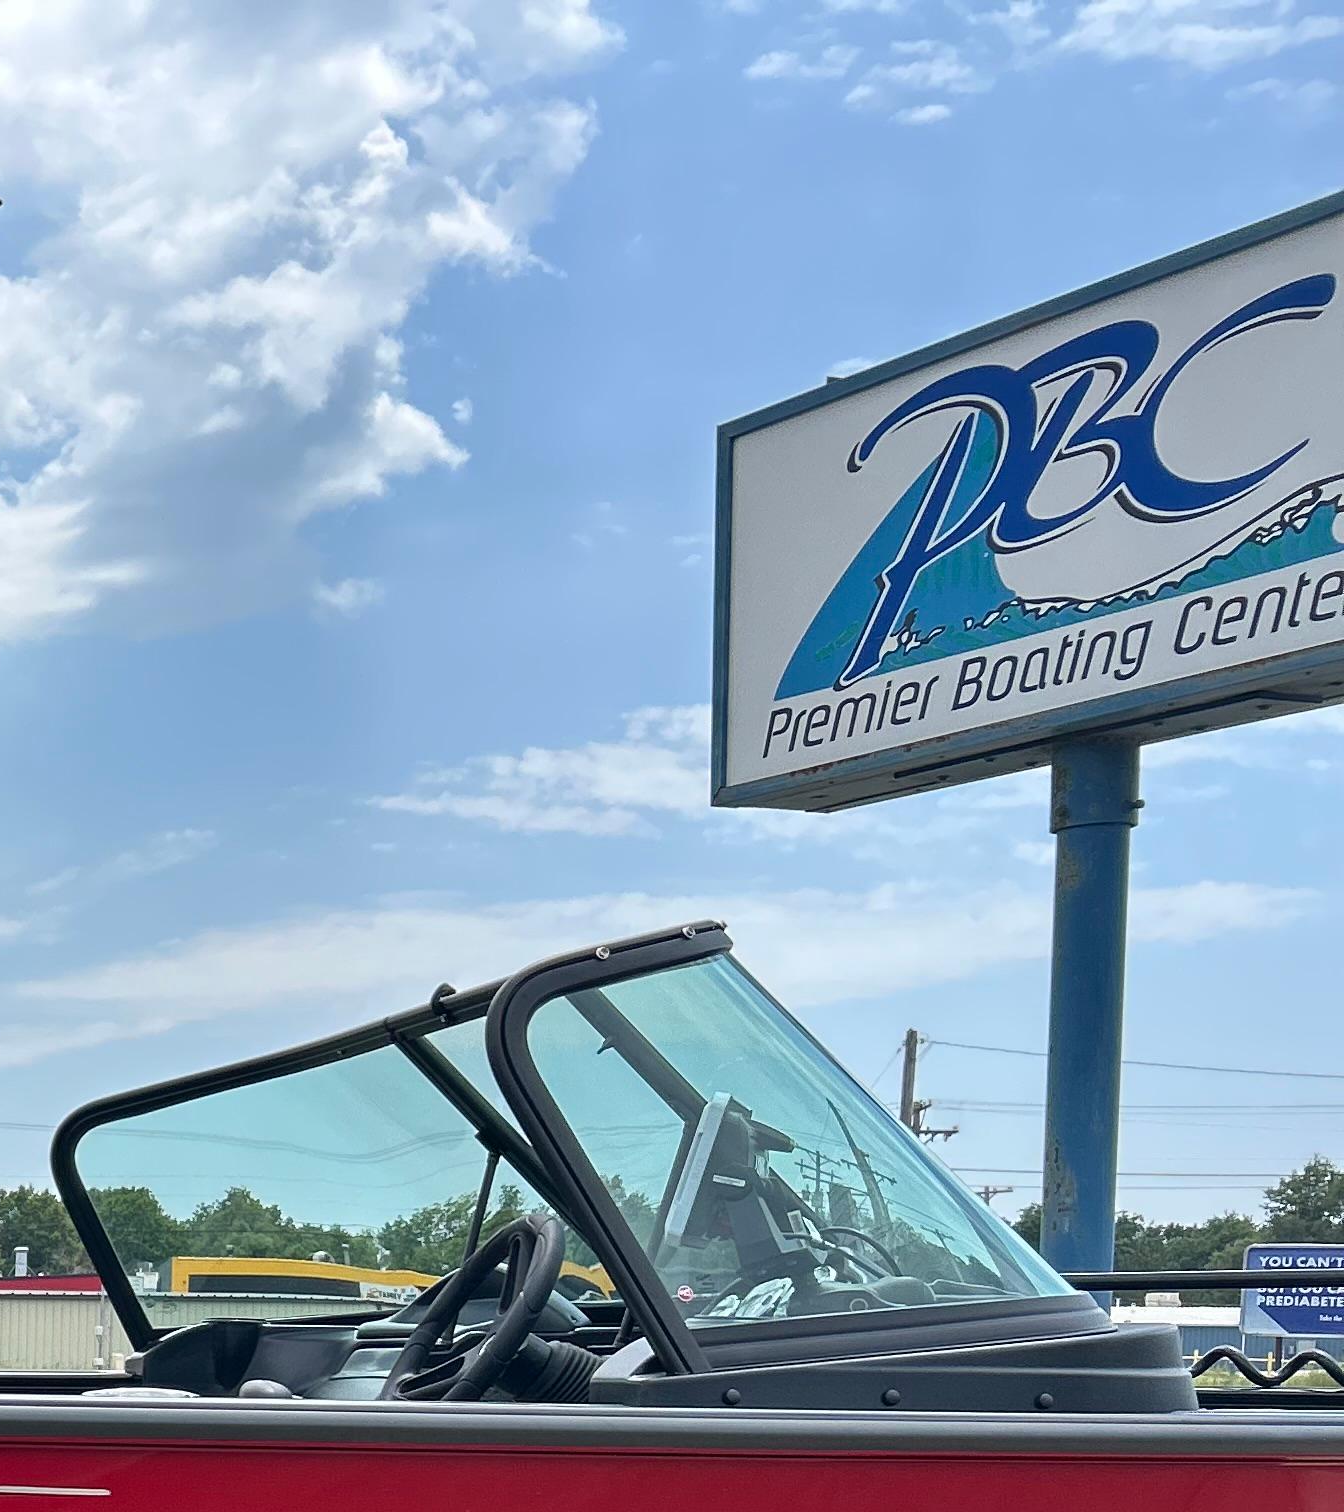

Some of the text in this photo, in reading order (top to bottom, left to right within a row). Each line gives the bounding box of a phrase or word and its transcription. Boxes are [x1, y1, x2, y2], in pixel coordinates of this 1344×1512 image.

[833, 273, 1337, 692] PBC
[761, 570, 1344, 759] Premier Boating Cente
[1259, 1256, 1344, 1268] YOU CAN'T
